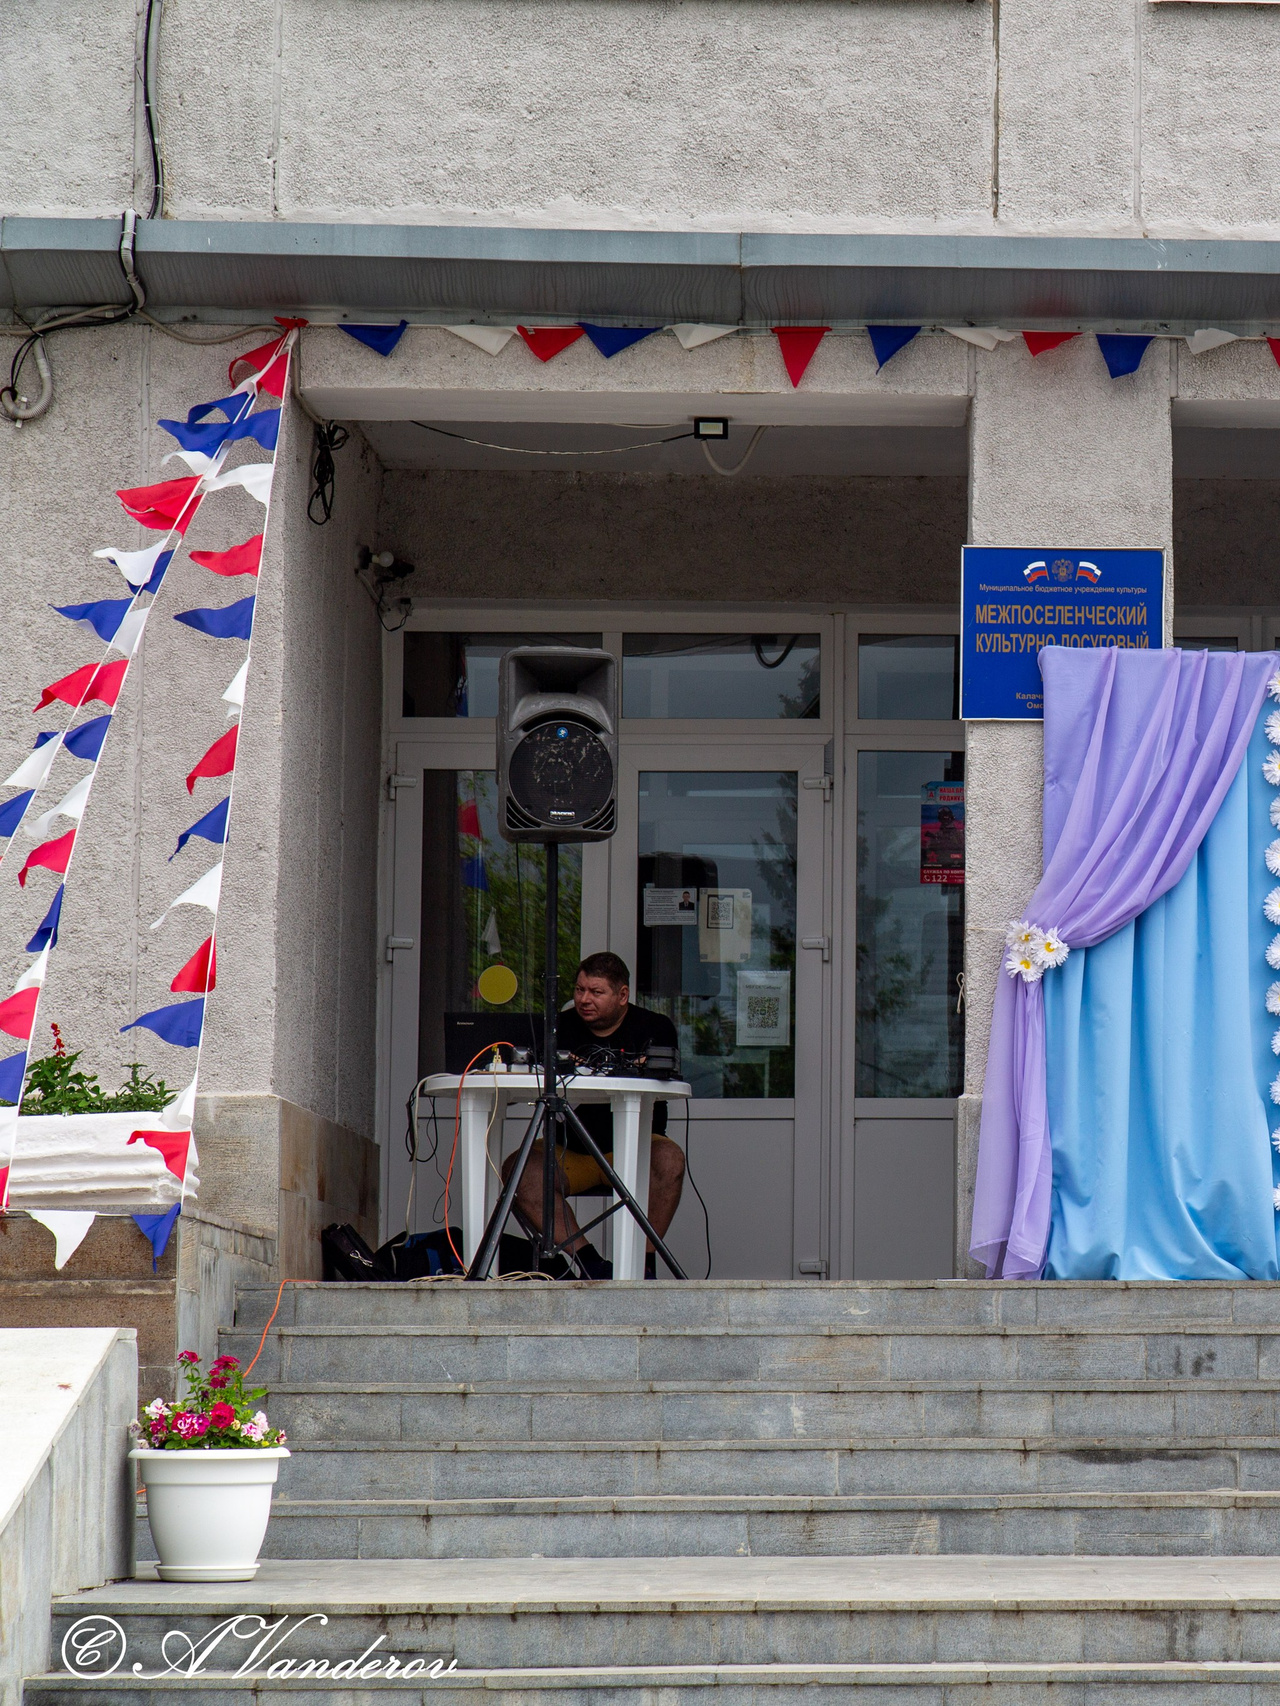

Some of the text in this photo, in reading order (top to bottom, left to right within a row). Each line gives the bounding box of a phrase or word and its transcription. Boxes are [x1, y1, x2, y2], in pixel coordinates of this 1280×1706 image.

[979, 583, 1148, 595] Муниципальное бюджетное учреждение культуры
[975, 602, 1148, 625] МЕЖПОСЕЛЕНЧЕСКИЙ
